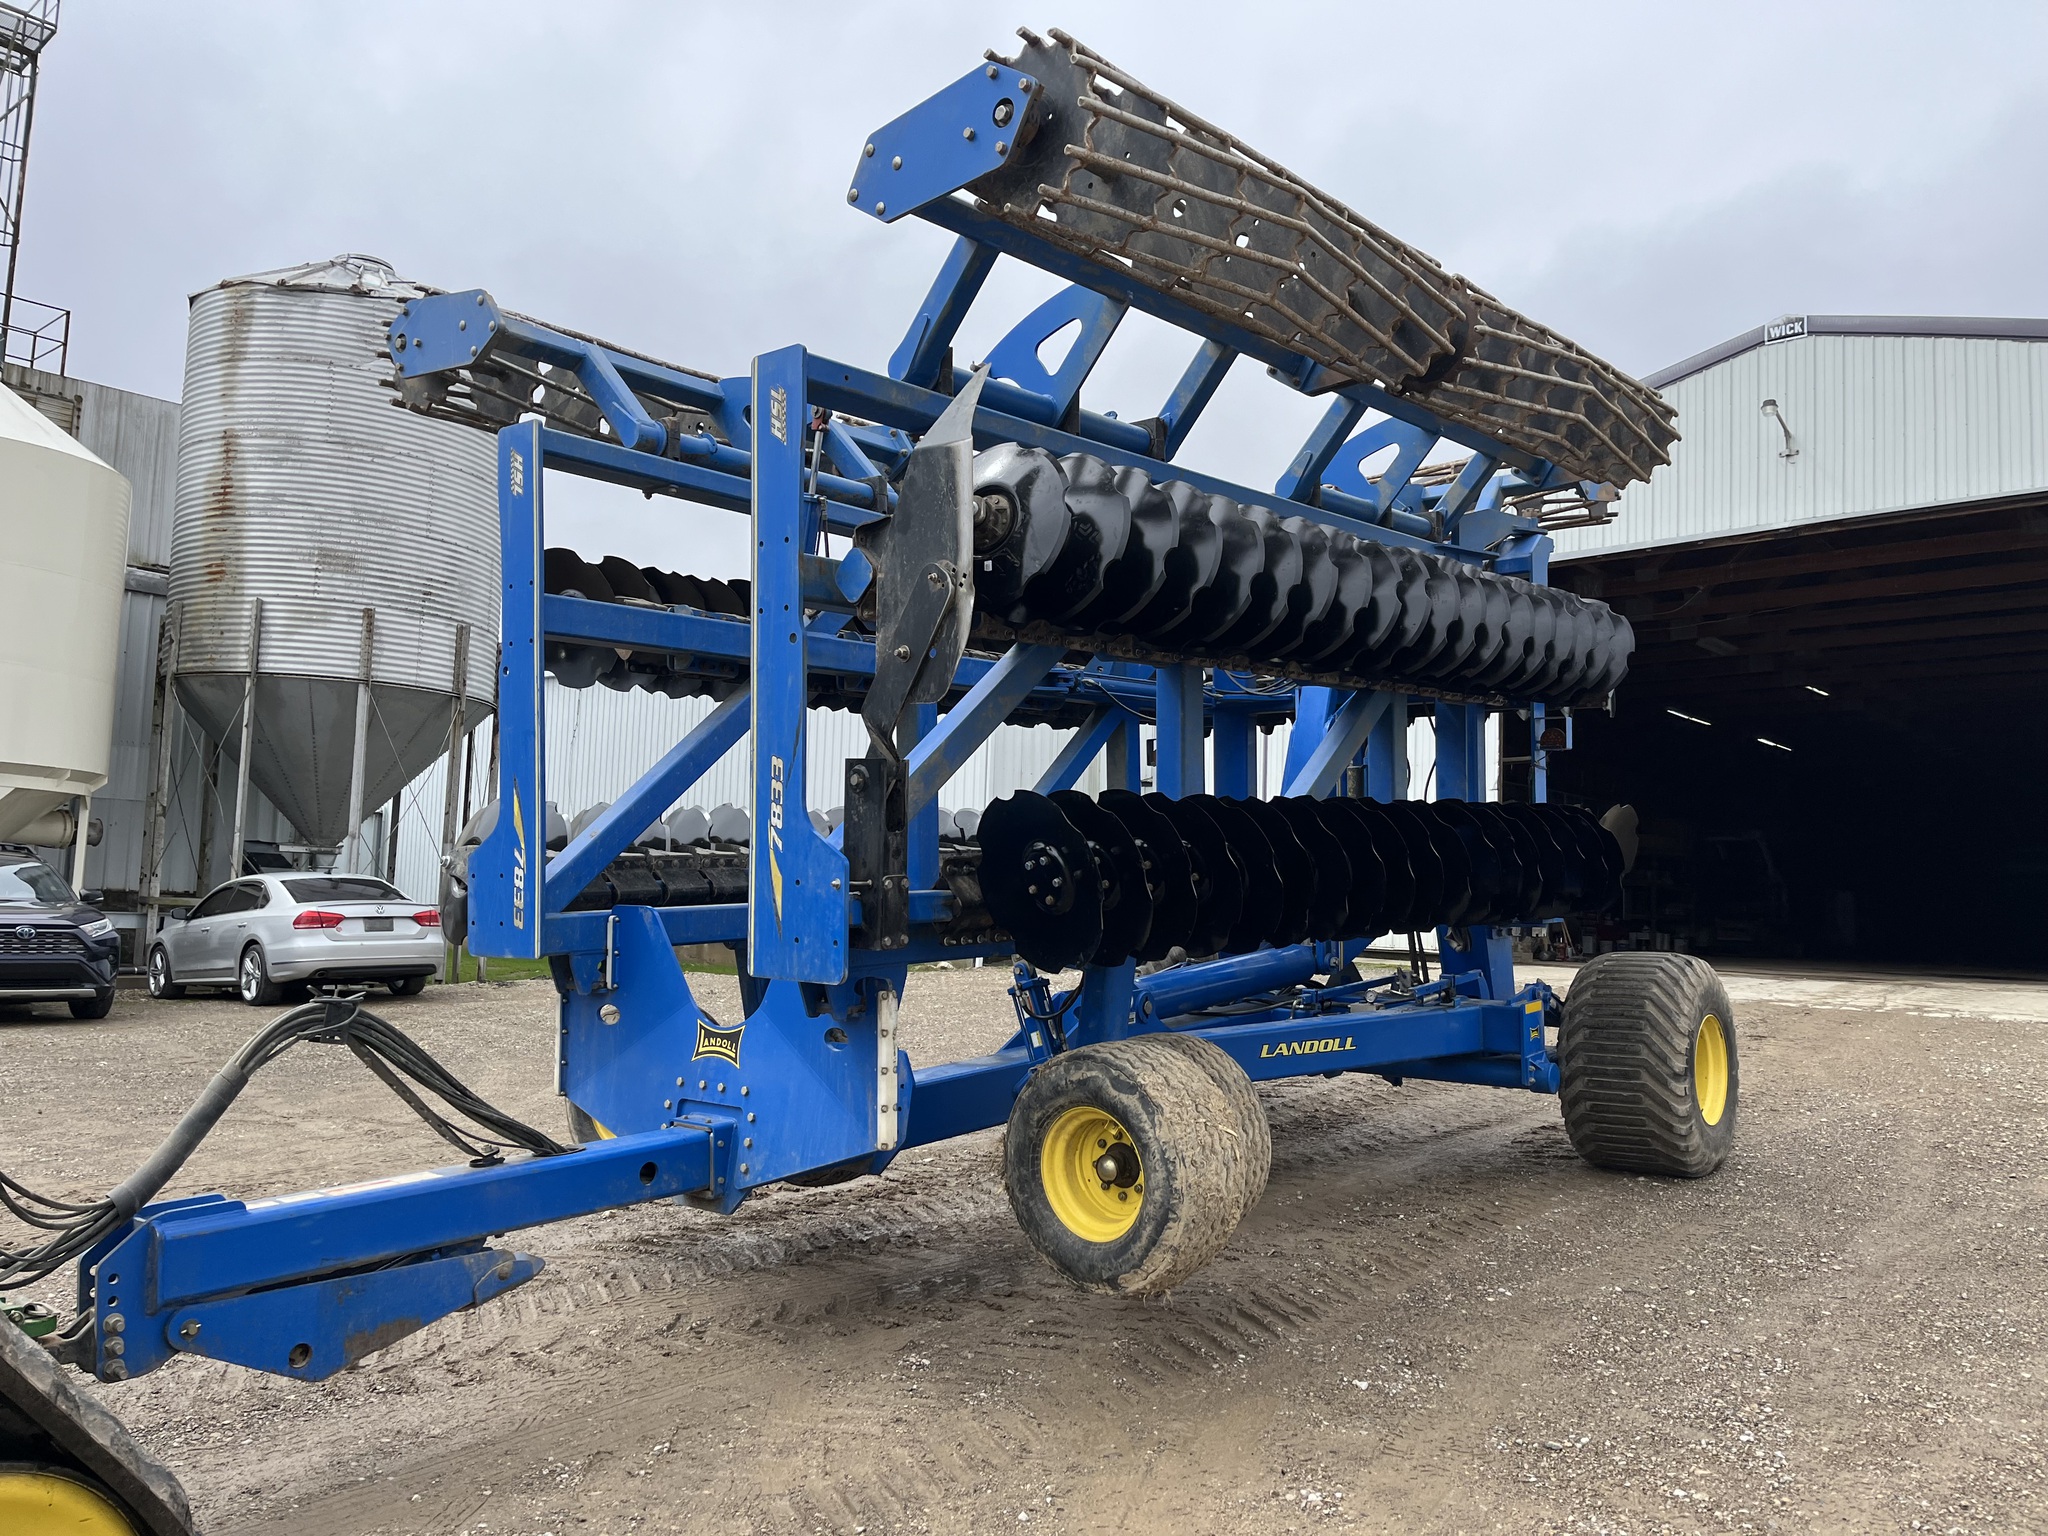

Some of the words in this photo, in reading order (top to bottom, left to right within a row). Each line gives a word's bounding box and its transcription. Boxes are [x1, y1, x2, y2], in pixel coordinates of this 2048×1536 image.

[1769, 321, 1803, 338] WICK
[770, 386, 784, 442] HSL
[771, 755, 783, 853] 7833
[514, 848, 525, 929] 7833
[698, 1028, 737, 1059] LANDOLL
[1260, 1036, 1357, 1058] LANDOLL
